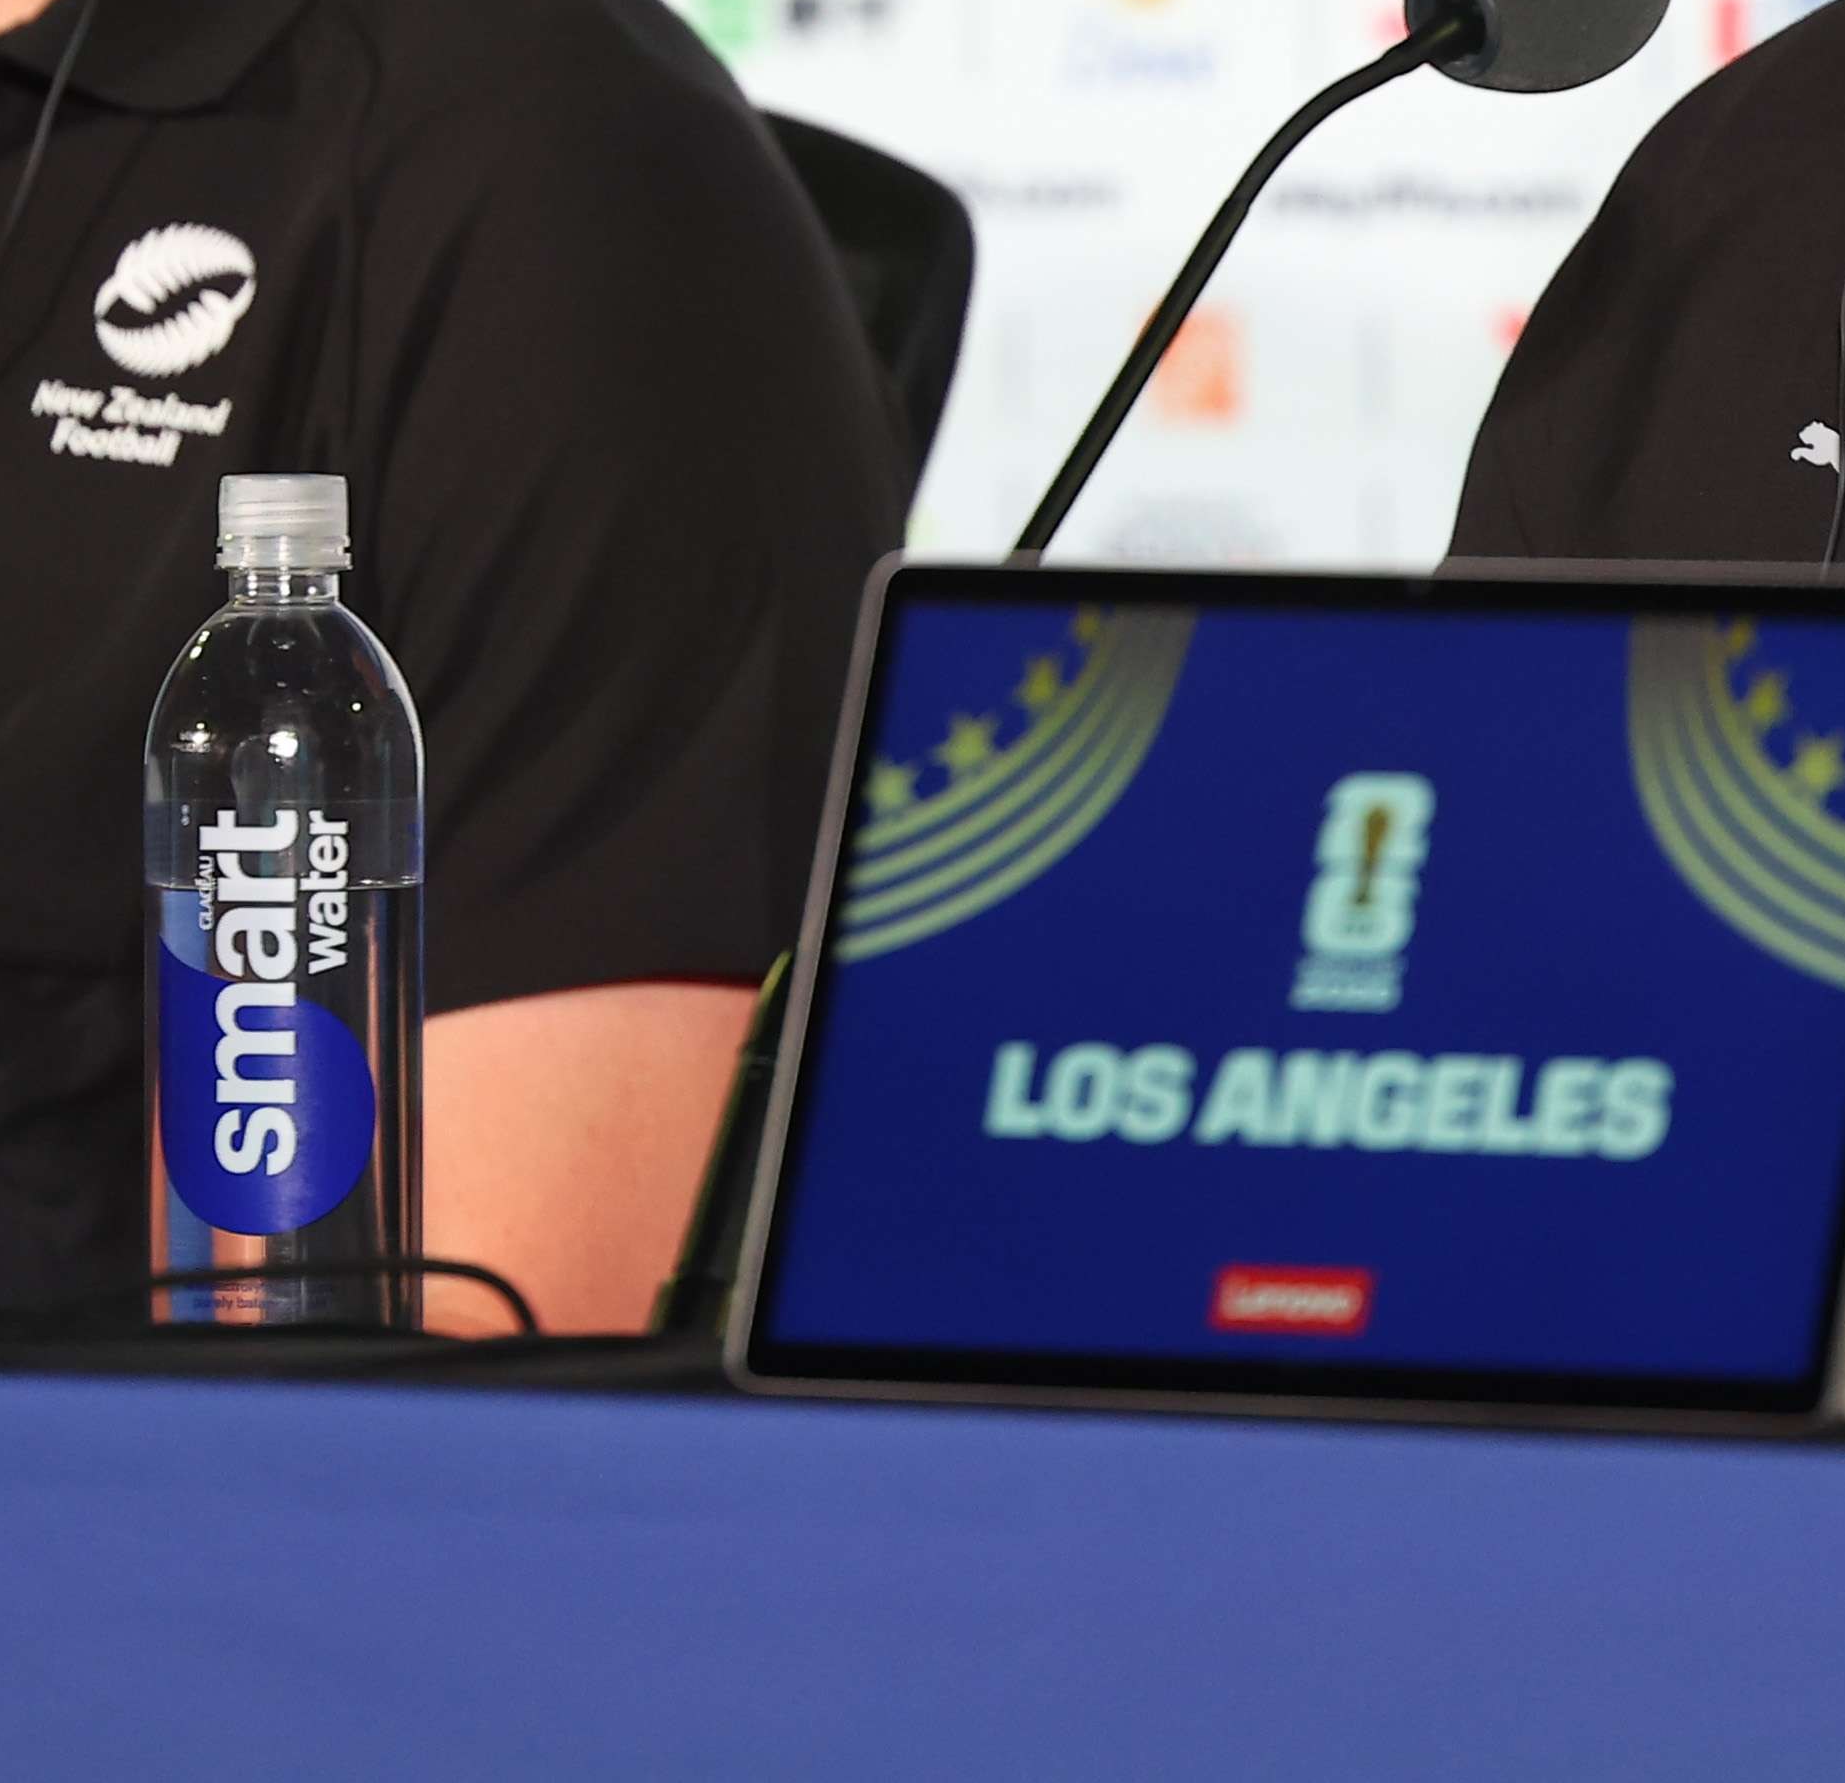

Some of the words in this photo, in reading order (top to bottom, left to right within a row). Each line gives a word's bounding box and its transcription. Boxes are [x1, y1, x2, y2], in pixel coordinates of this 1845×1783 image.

[300, 809, 350, 975] water
[199, 808, 299, 1177] smart
[984, 1042, 1194, 1146] LOS
[1194, 1048, 1674, 1160] ANGELES
